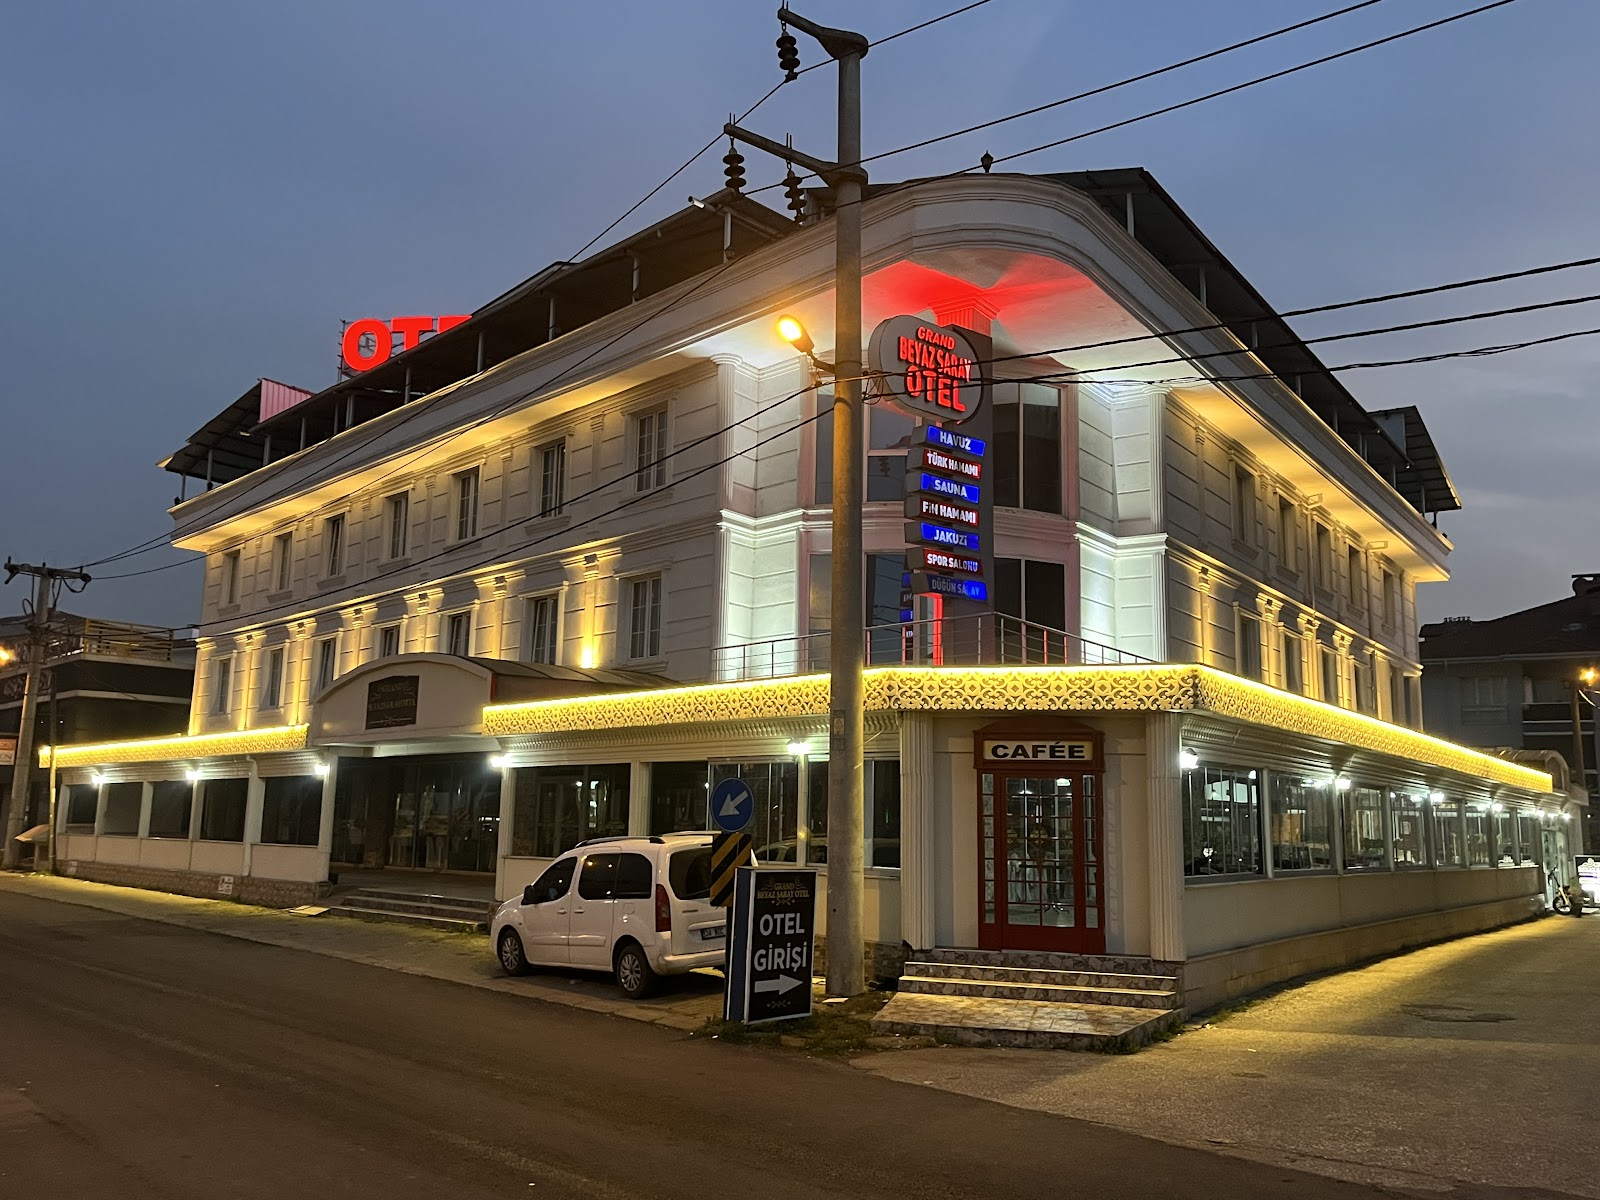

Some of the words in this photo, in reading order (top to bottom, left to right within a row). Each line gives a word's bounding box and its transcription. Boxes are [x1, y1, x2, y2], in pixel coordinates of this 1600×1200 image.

[917, 326, 956, 350] GRAND
[906, 365, 966, 412] OTEL
[940, 431, 972, 451] HAVUZ
[927, 451, 948, 469] TÜRK
[934, 479, 968, 498] SAUNA
[939, 504, 976, 524] HAMAMI
[927, 553, 948, 567] SPOR
[948, 557, 978, 573] SALONU
[931, 577, 957, 594] DÜĞÜN
[991, 741, 1086, 759] CAFÉE
[773, 882, 795, 890] GRAND
[776, 890, 794, 899] SARAY
[794, 889, 810, 898] OTEL
[759, 912, 806, 936] OTEL
[753, 941, 808, 973] GİRİŞİ
